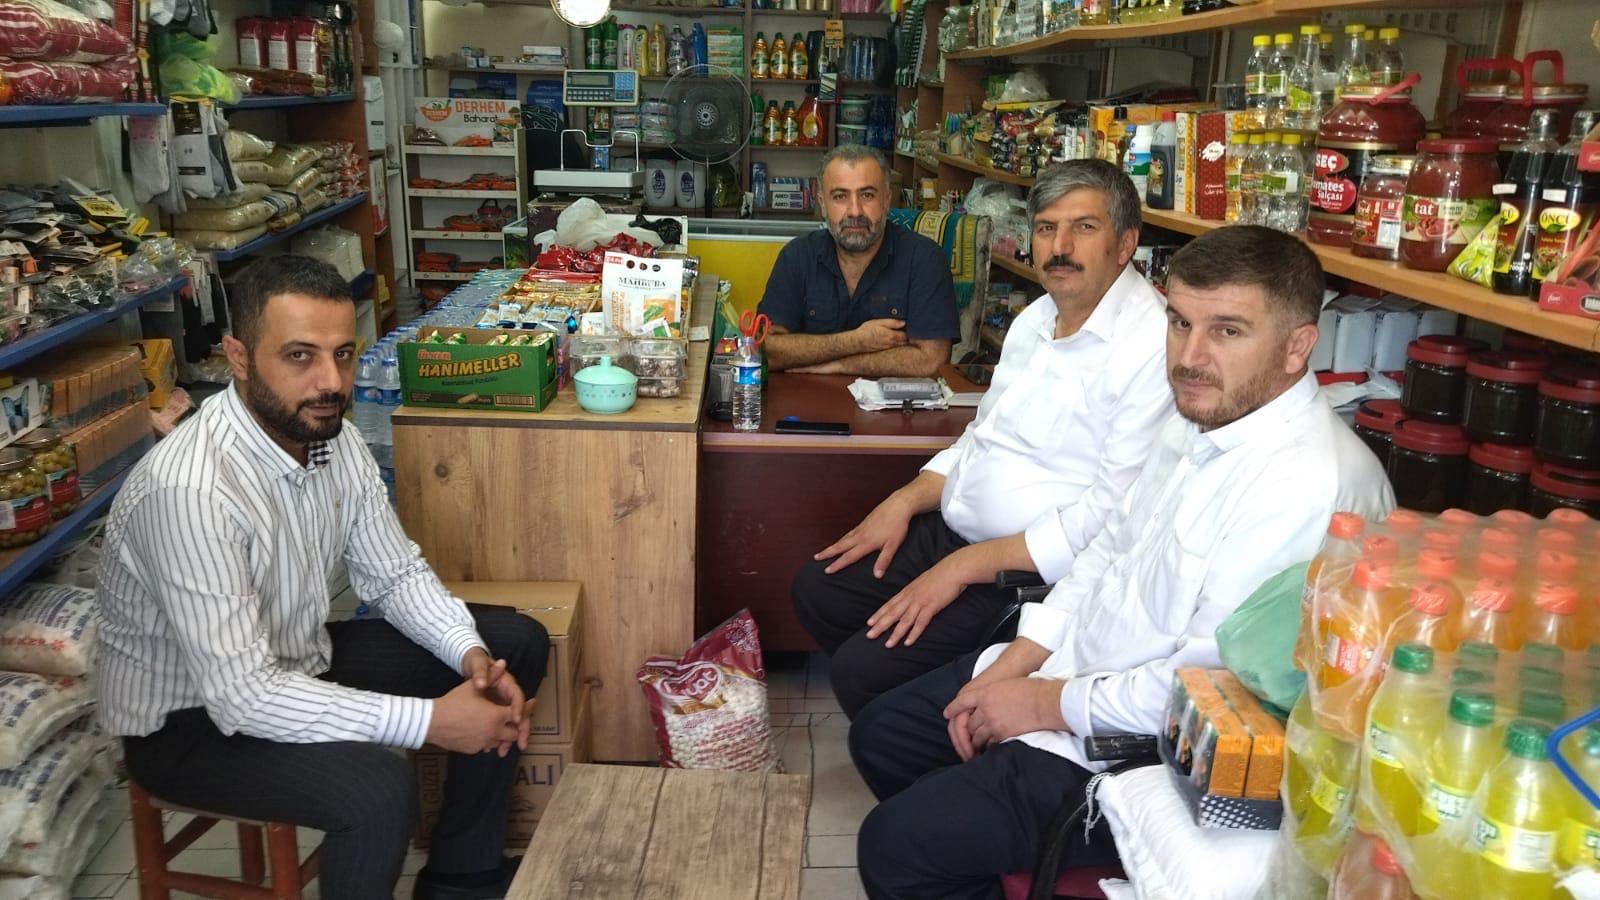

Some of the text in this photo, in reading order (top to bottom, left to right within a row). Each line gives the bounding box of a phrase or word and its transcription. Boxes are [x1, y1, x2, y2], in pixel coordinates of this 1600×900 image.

[455, 101, 506, 113] DERHEM
[1315, 154, 1338, 172] SEÇ
[1317, 190, 1343, 201] Salçası
[1414, 203, 1435, 216] tat
[418, 352, 521, 378] HANIMELLER
